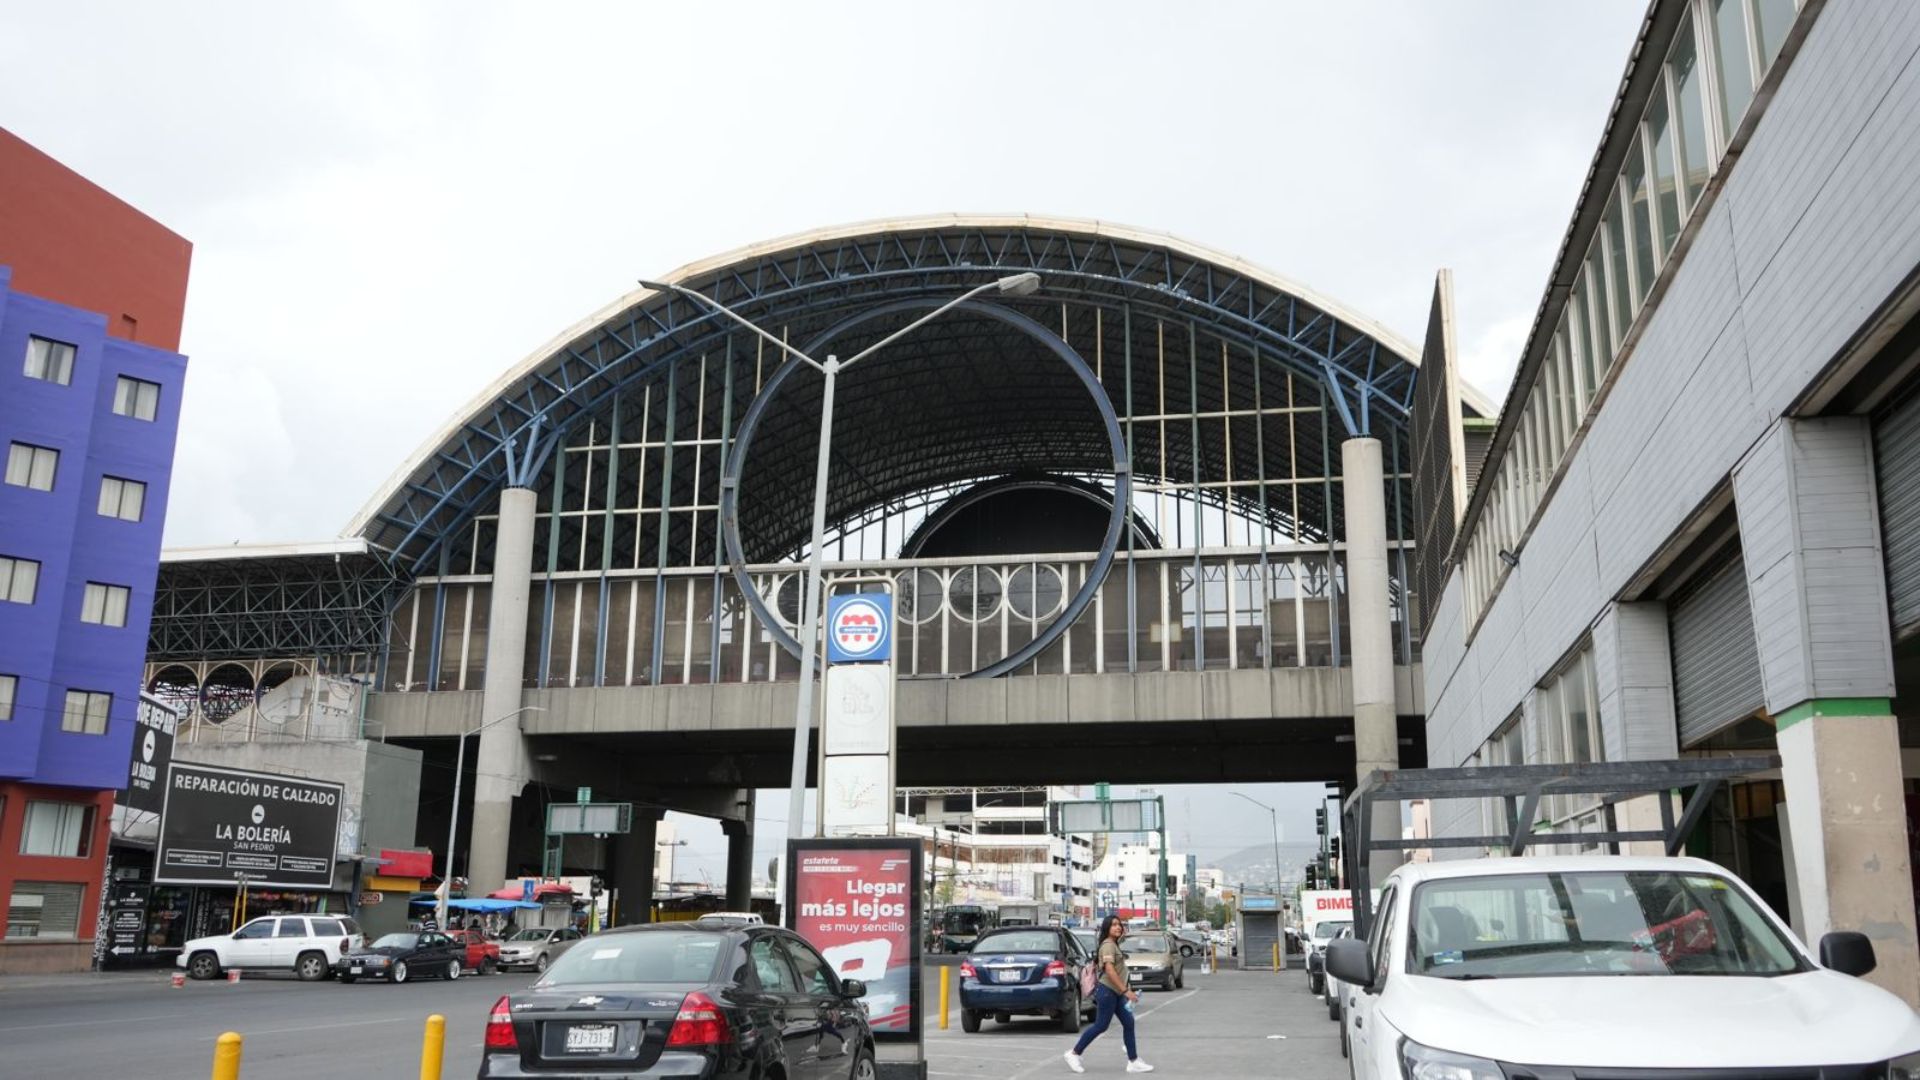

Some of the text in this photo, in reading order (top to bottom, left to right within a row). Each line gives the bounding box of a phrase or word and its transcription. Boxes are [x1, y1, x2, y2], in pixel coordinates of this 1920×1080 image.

[175, 774, 336, 806] REPARACIÓN DE CALZADO
[215, 824, 292, 844] LA BOLERÍA
[233, 841, 275, 852] SAN PEDRO
[846, 879, 906, 897] Llegar
[802, 898, 905, 921] más lejos
[1316, 898, 1353, 910] BIMB
[819, 921, 905, 934] es muy sencillo
